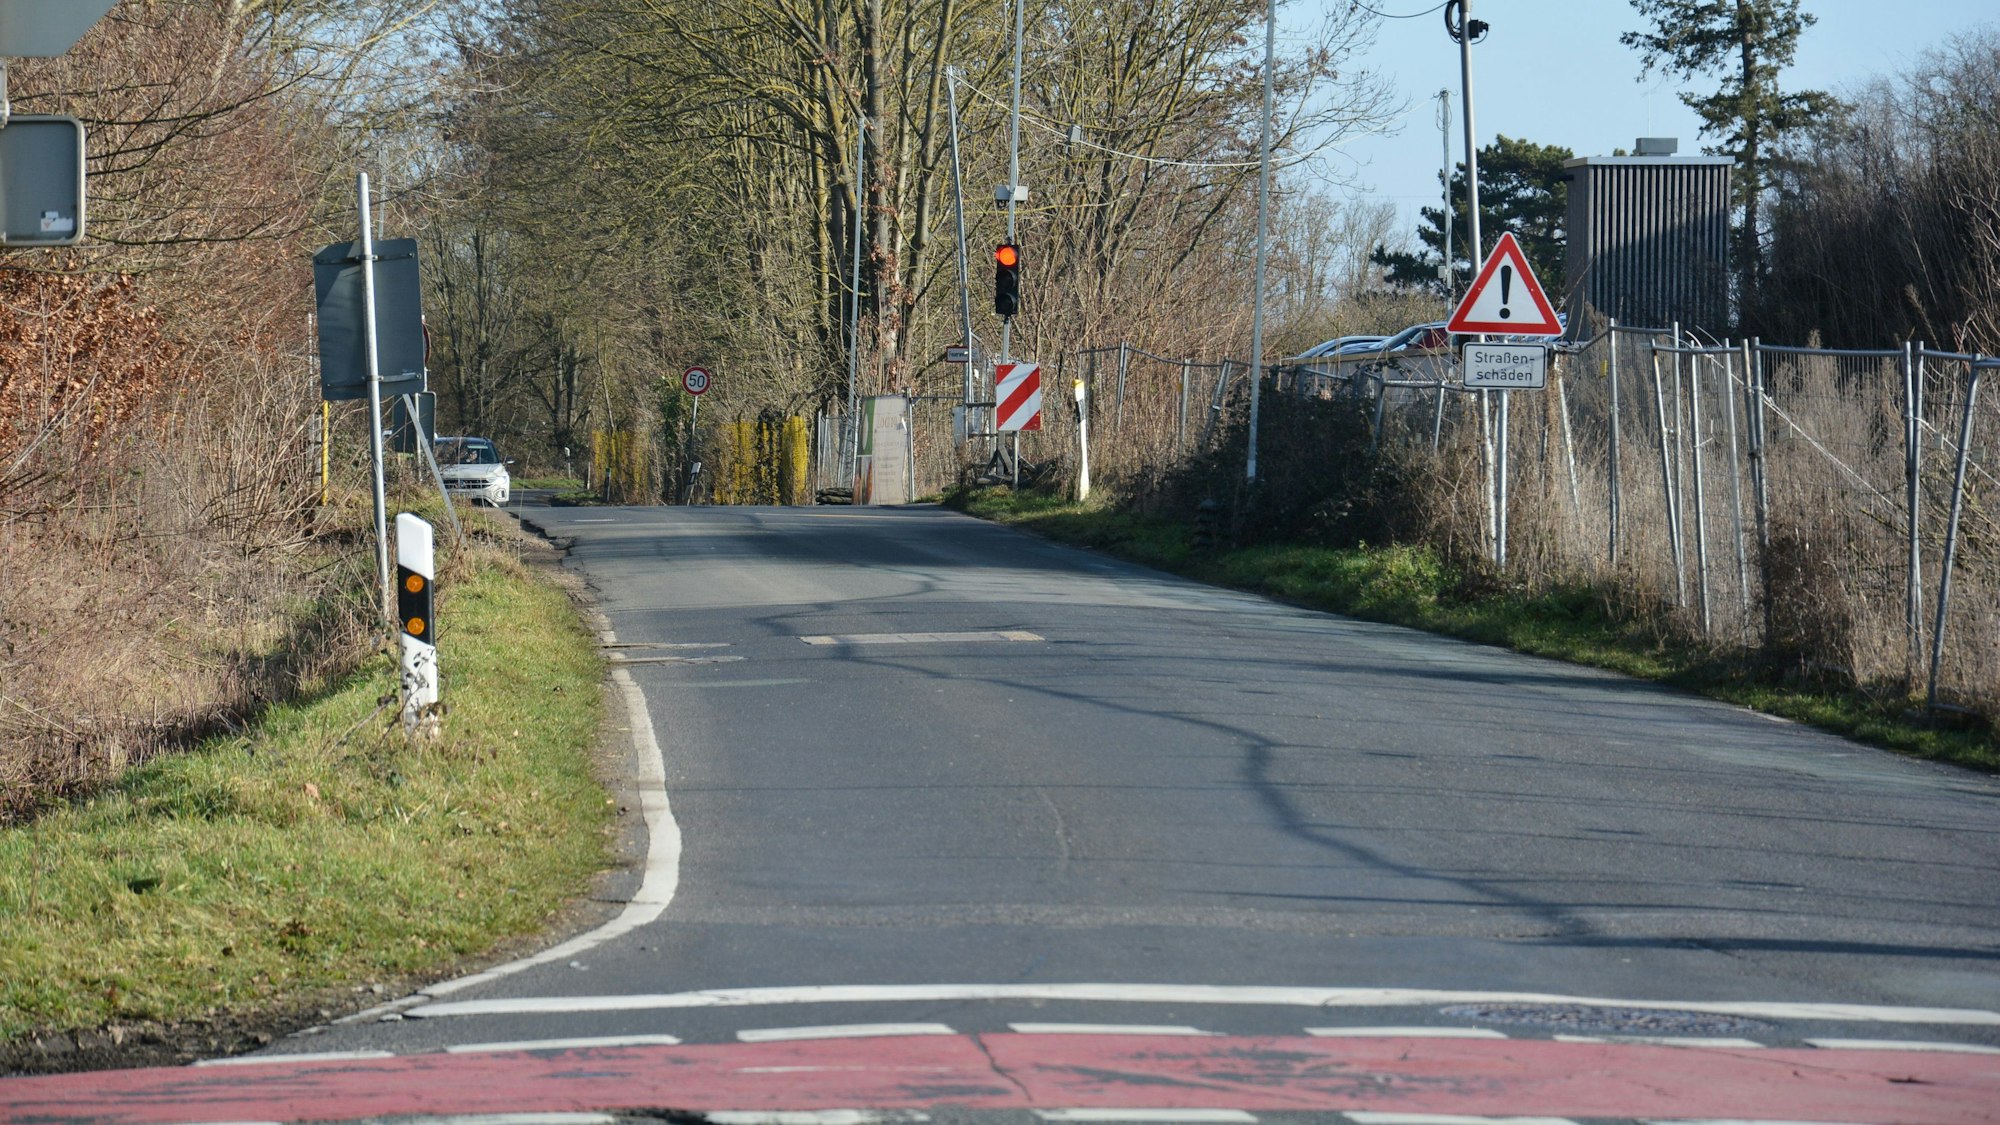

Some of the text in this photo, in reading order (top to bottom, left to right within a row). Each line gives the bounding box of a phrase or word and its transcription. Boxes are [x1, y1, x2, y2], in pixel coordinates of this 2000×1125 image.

[1475, 351, 1535, 364] Straßen-
[689, 374, 705, 388] 50
[1476, 369, 1533, 381] schäden
